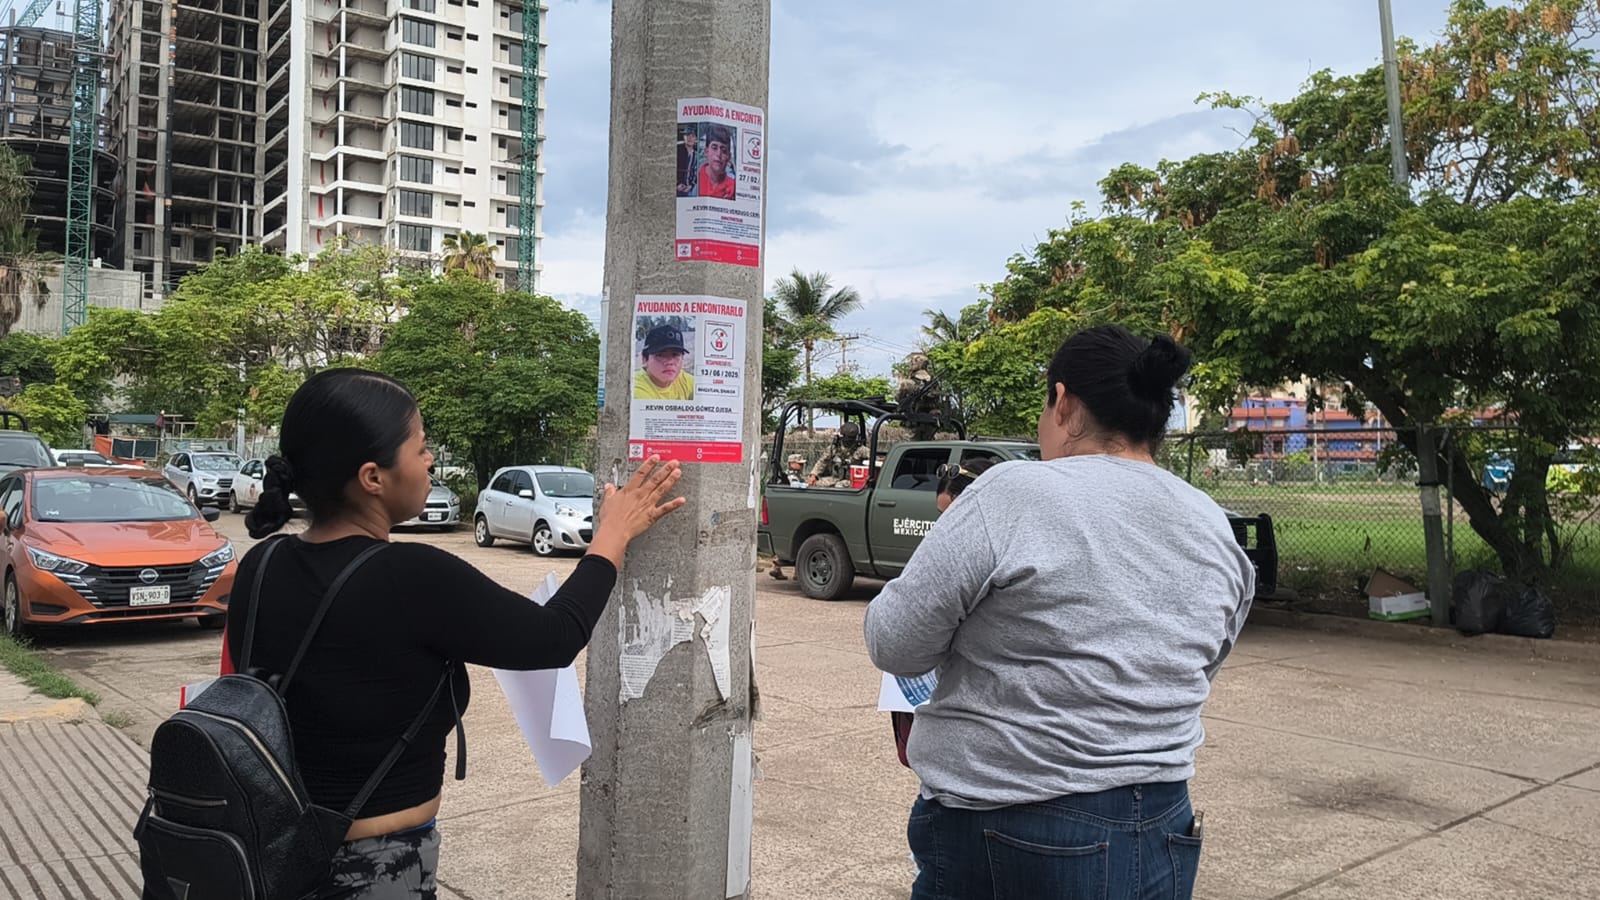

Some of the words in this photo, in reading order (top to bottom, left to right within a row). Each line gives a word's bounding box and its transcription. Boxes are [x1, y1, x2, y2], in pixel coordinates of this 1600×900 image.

[682, 105, 724, 117] AYUDANOS
[724, 109, 730, 119] A
[637, 302, 681, 313] AYUDANOS
[683, 302, 689, 313] A
[691, 302, 743, 317] ENCONTRARLO
[893, 518, 937, 530] EJÉRCITO
